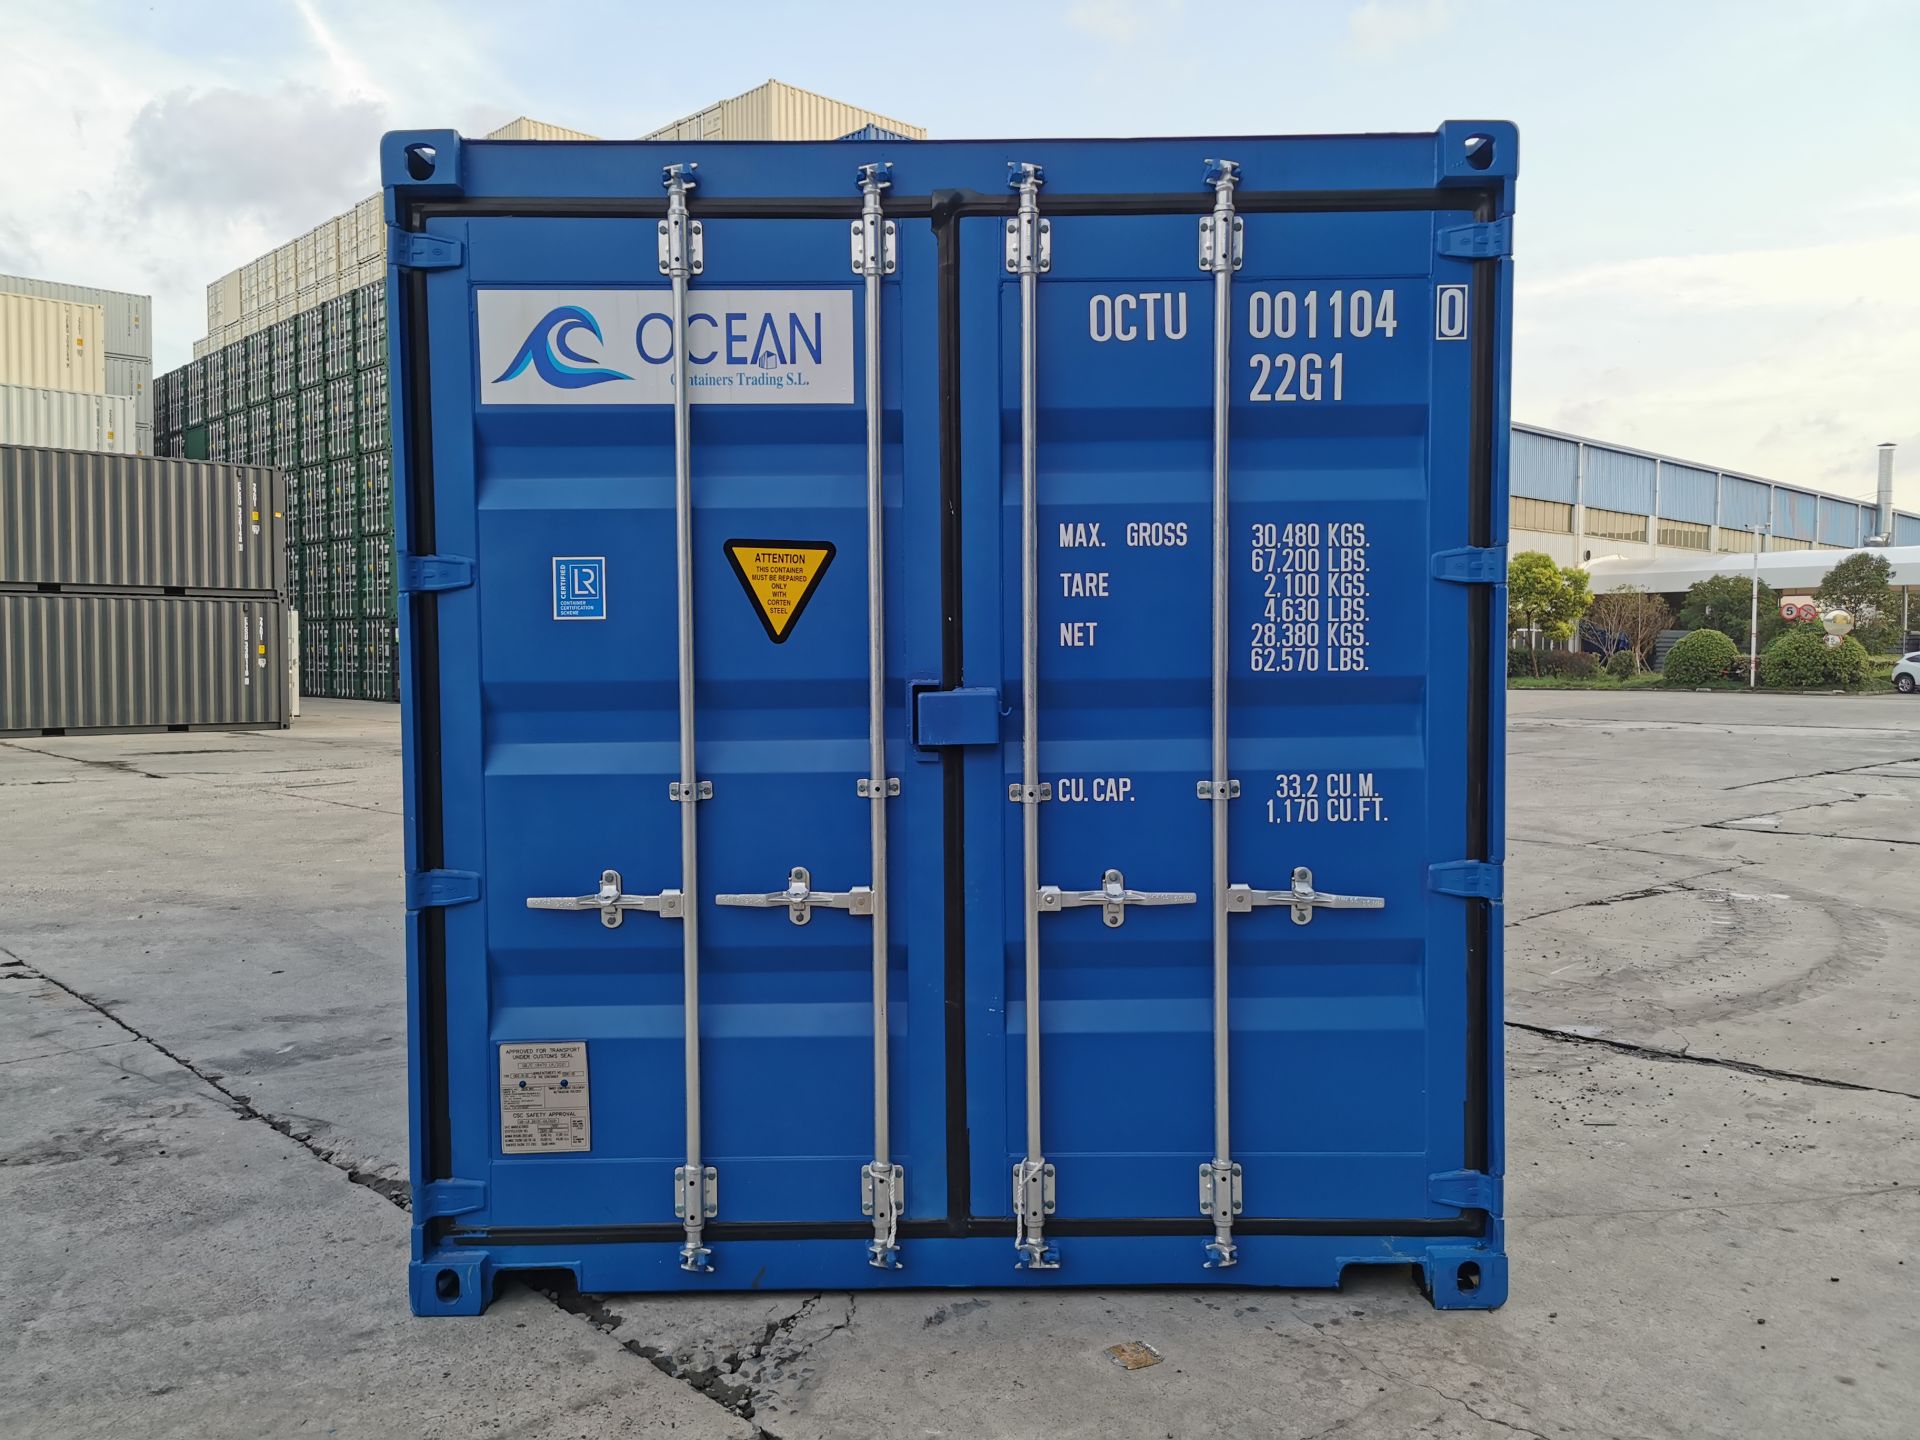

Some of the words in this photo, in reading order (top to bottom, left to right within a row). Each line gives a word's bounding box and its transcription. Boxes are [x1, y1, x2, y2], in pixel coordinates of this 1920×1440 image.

[1089, 292, 1187, 342] OCTU
[1249, 289, 1398, 339] 001104
[1440, 288, 1463, 336] 0
[635, 312, 822, 365] OCEAN
[670, 372, 733, 386] Cntainers
[736, 372, 783, 389] Trading
[786, 372, 810, 386] S.L.
[1249, 352, 1343, 402] 22G1
[1059, 522, 1106, 548] MAX.
[1126, 522, 1188, 547] GROSS
[1251, 523, 1319, 549] 30,480
[1327, 523, 1370, 548] KGS.
[755, 553, 806, 564] ATTENTION
[770, 566, 804, 574] CONTAINER
[1251, 548, 1319, 574] 67,200
[1328, 548, 1370, 572] LBS.
[574, 568, 597, 594] LR
[769, 574, 777, 582] BE
[771, 582, 788, 590] ONLY
[1059, 572, 1109, 597] TARE
[1264, 573, 1319, 598] 2,100
[1327, 573, 1370, 597] KGS.
[767, 598, 791, 606] CORTEN
[769, 607, 788, 615] STEEL
[1264, 598, 1319, 623] 4,630
[1327, 598, 1370, 622] LBS.
[1786, 606, 1793, 616] 5
[1060, 622, 1098, 647] NET
[1251, 622, 1319, 648] 28,380
[1327, 622, 1370, 647] KGS.
[1251, 647, 1319, 672] 62,570
[1327, 647, 1369, 672] LBS.
[1276, 774, 1318, 798] 33.2
[1326, 773, 1379, 797] CU.M.
[1266, 798, 1319, 824] 1,170
[1327, 798, 1388, 822] CU.FT.
